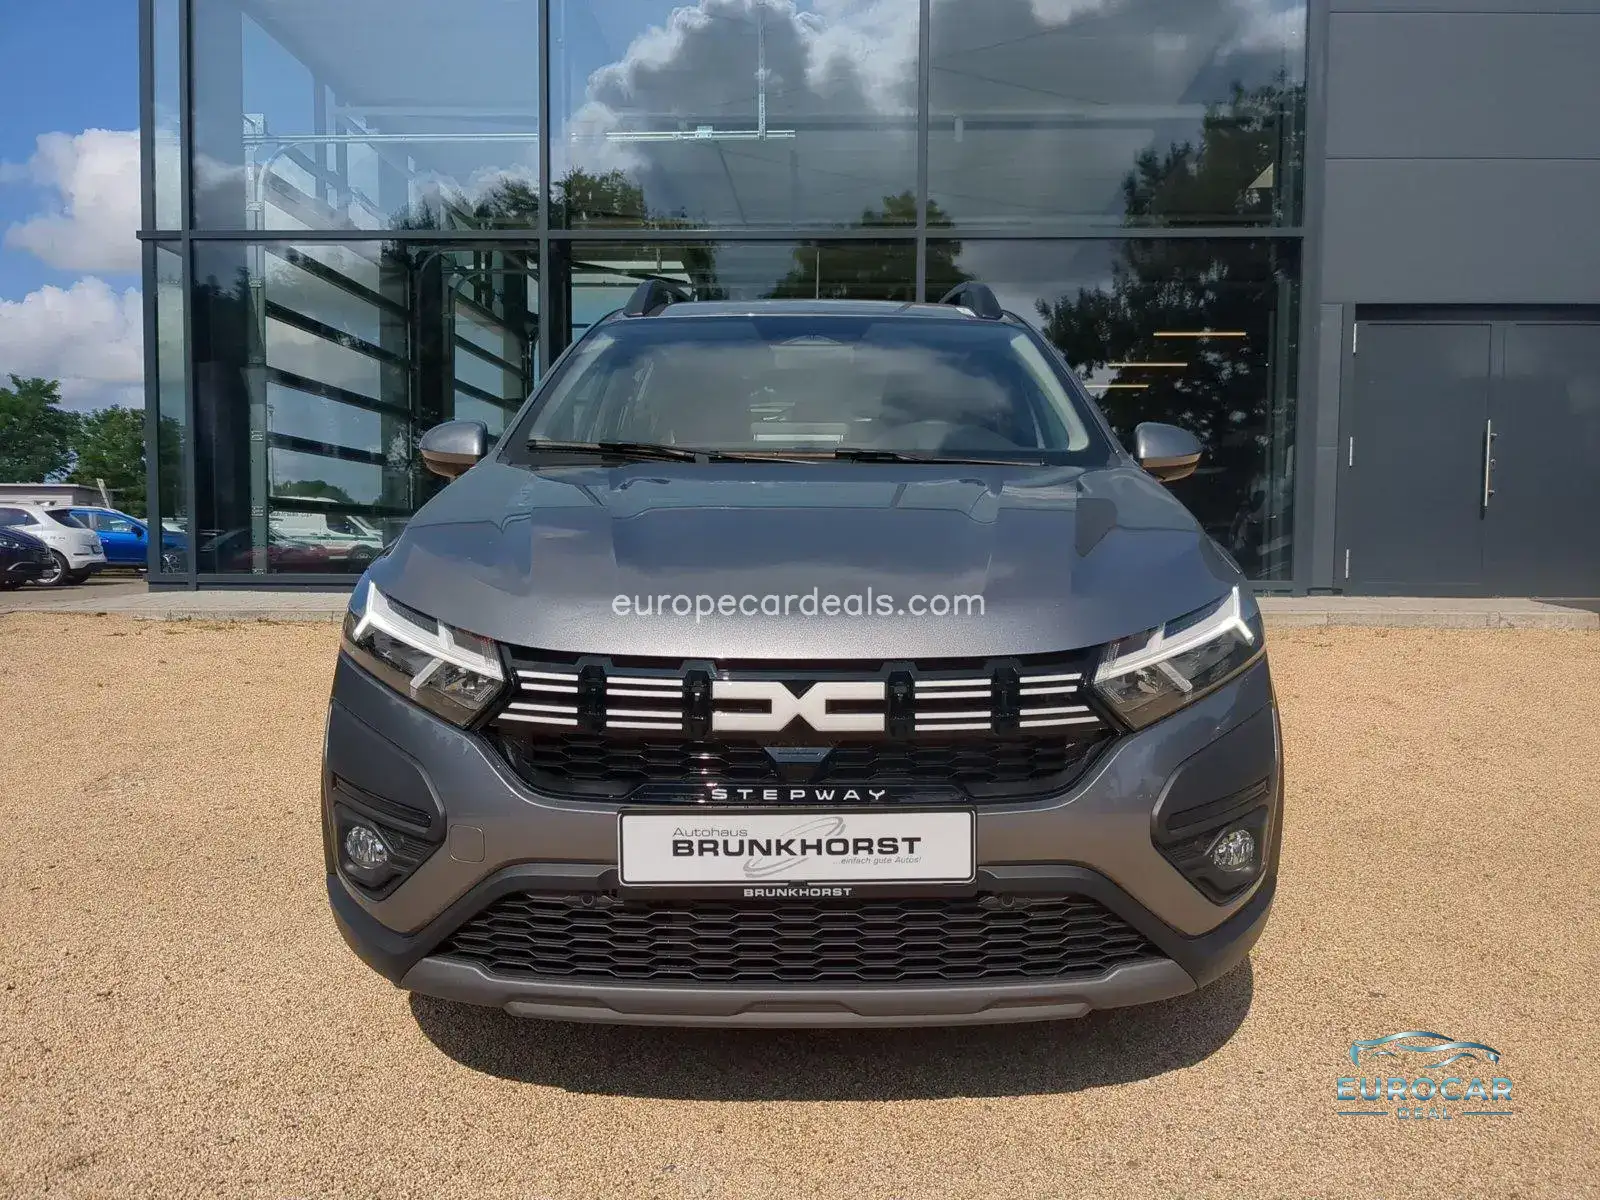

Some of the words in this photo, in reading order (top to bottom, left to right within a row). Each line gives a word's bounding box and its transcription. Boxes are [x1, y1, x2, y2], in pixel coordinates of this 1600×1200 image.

[711, 789, 886, 801] STEPWAY
[672, 827, 748, 837] Autohaus
[672, 837, 921, 857] BRUNKHORST
[873, 857, 892, 866] gute
[894, 856, 922, 864] Autos!
[743, 888, 852, 897] BRUNKHORST
